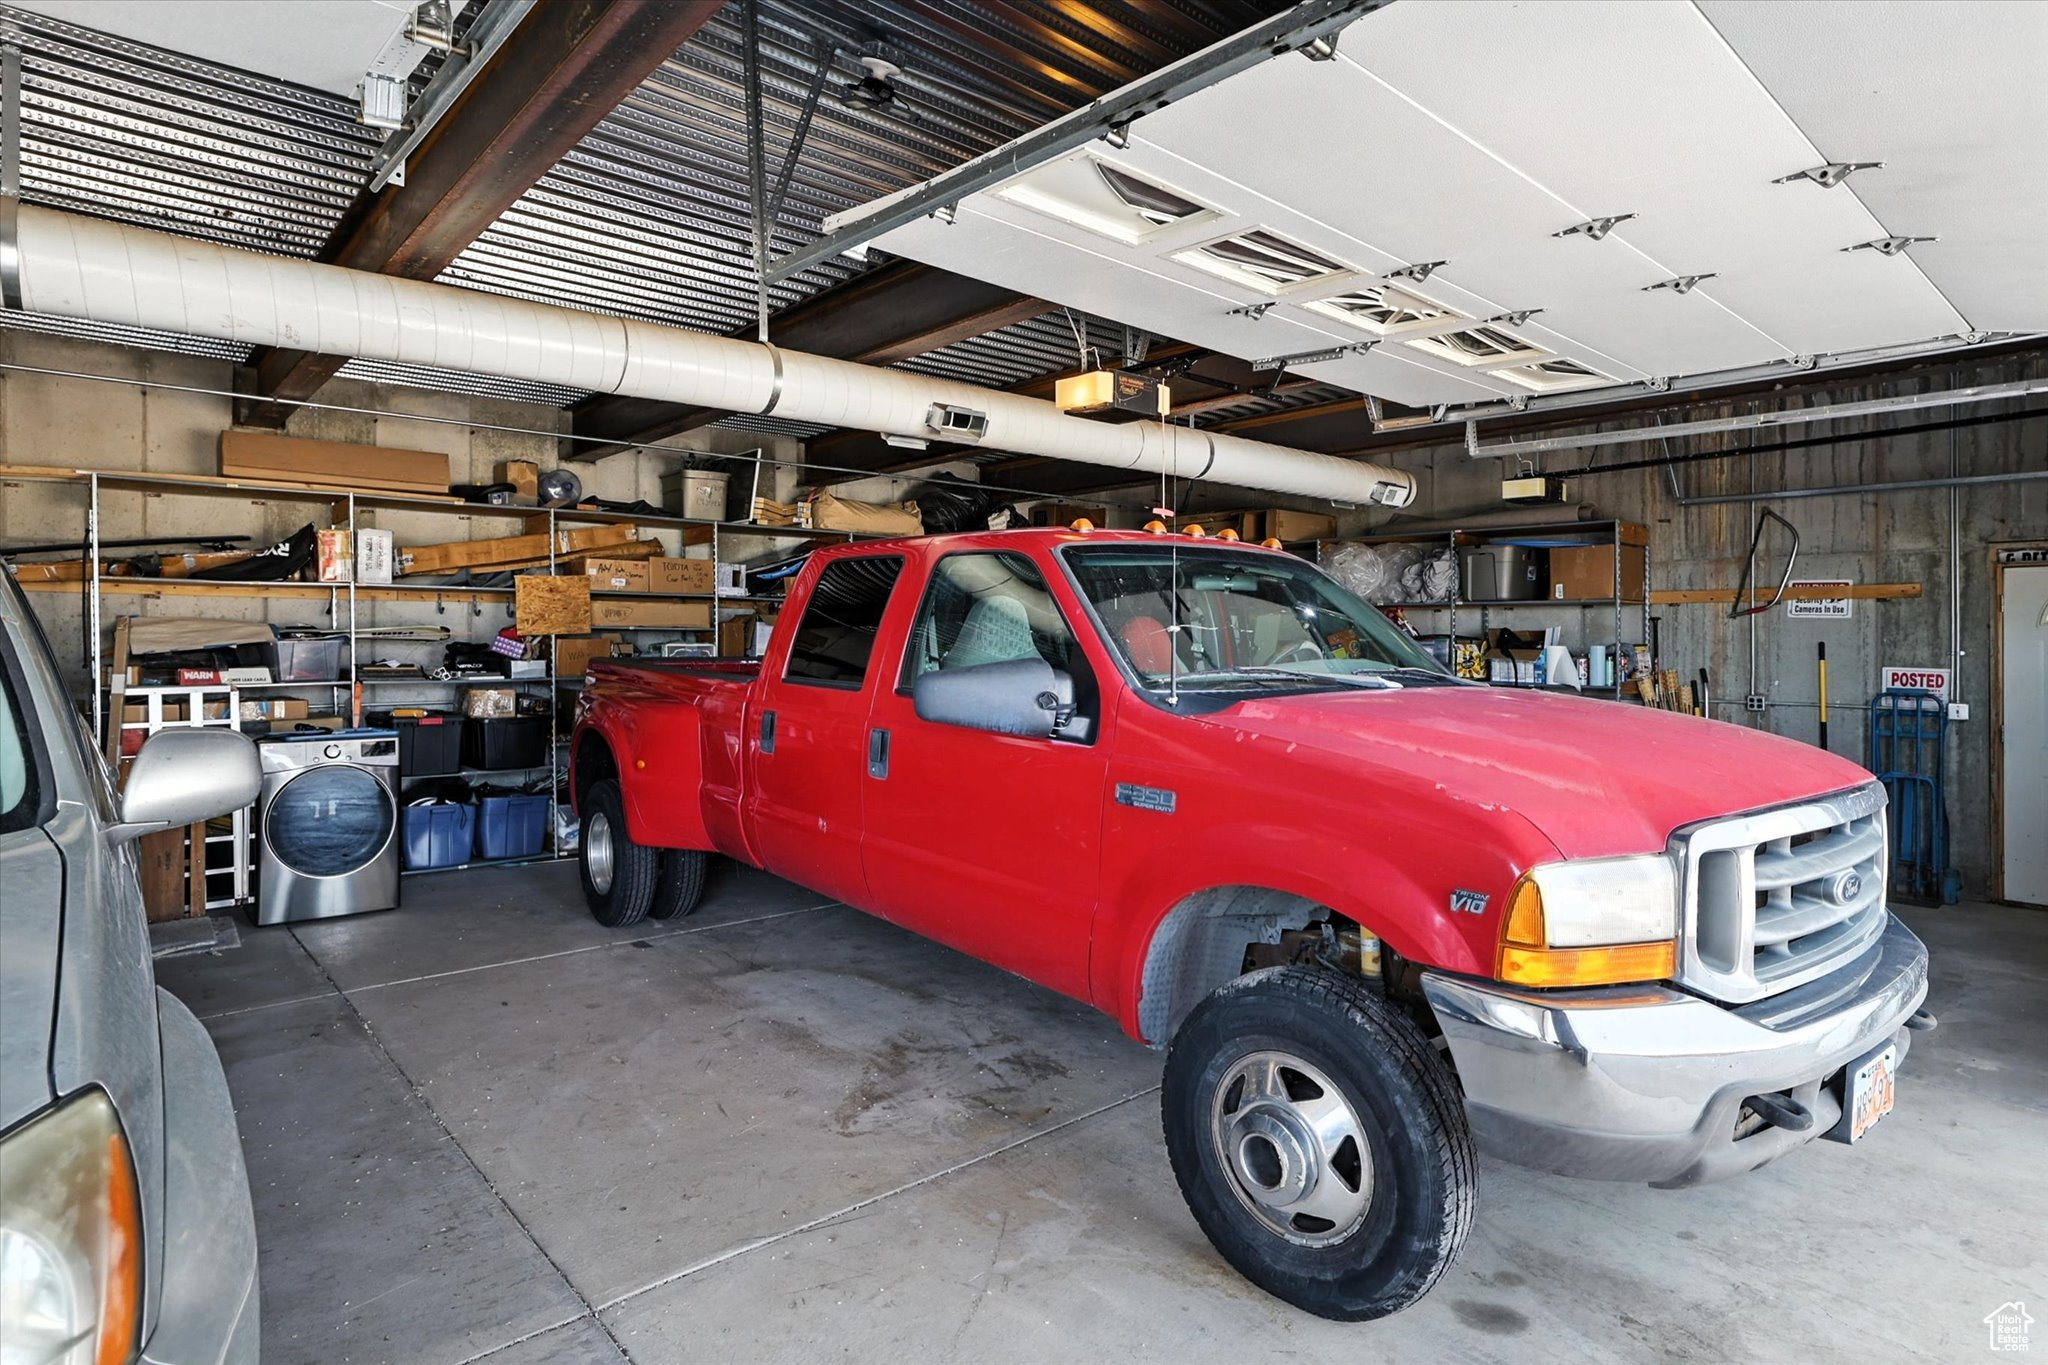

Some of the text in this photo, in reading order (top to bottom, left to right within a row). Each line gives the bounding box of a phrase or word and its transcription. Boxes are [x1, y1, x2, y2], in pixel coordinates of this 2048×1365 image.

[1795, 605, 1845, 614] Cameras In Use
[183, 671, 214, 680] WARN
[1891, 672, 1945, 689] POSTED
[1133, 801, 1172, 813] SUPER DUTY
[1456, 890, 1489, 900] TRITON
[1450, 894, 1487, 914] V10
